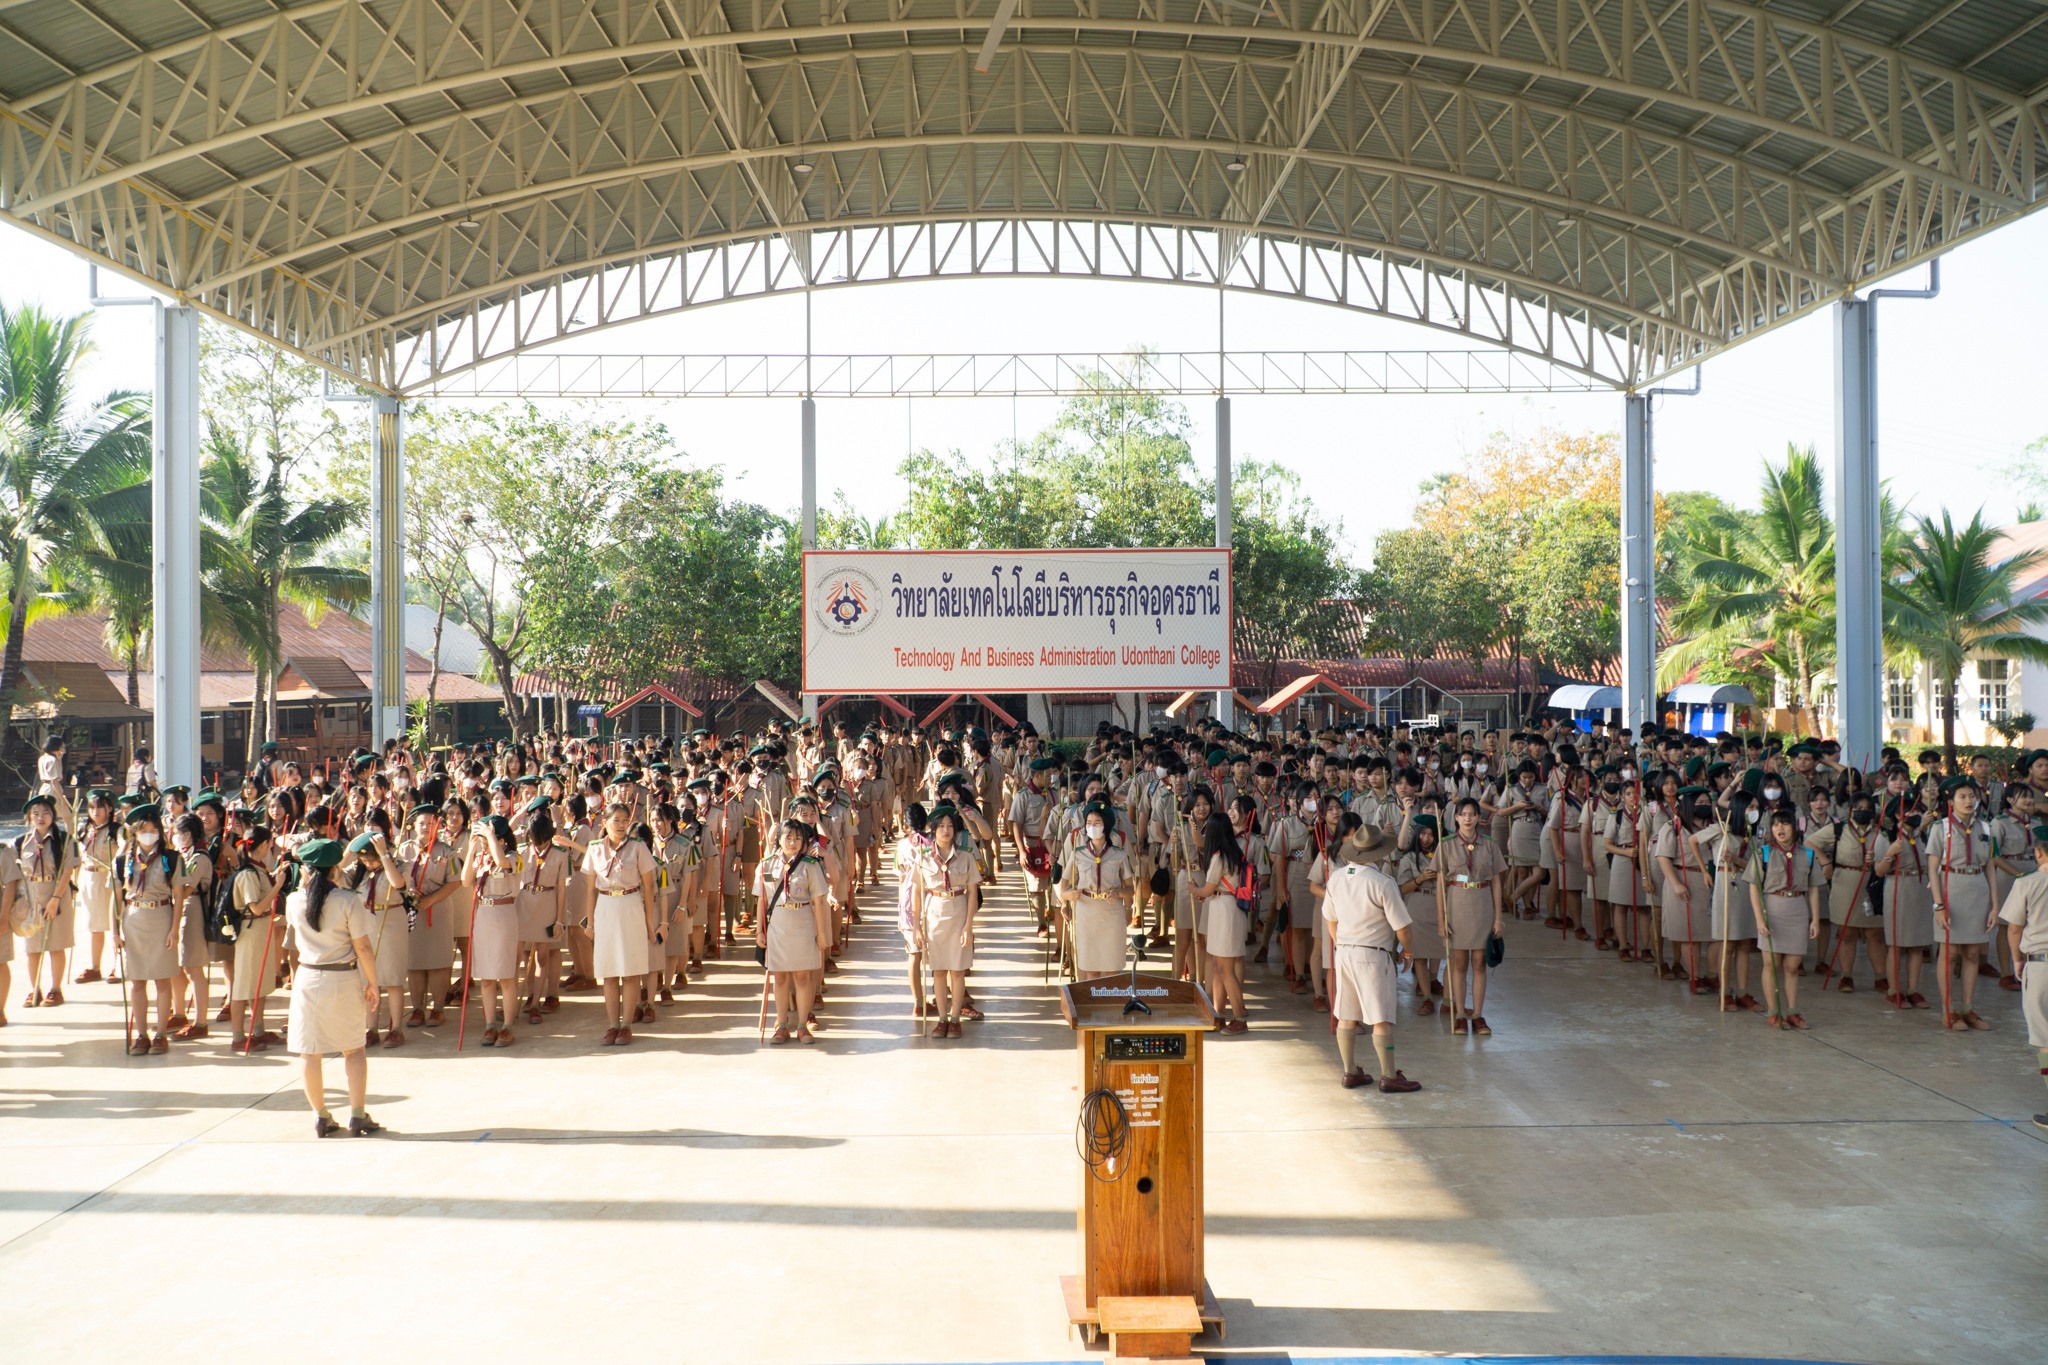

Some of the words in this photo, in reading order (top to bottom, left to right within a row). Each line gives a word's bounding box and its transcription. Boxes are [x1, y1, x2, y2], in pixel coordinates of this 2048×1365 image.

[891, 566, 1221, 635] วิทยาลัยเทคโนโลยีบริหารธุรกิจอุดรธานี
[893, 646, 956, 672] Technology
[960, 646, 982, 667] And
[986, 646, 1035, 667] Business
[1039, 645, 1117, 667] Administration
[1121, 645, 1176, 666] Udonthani
[1181, 644, 1221, 670] College
